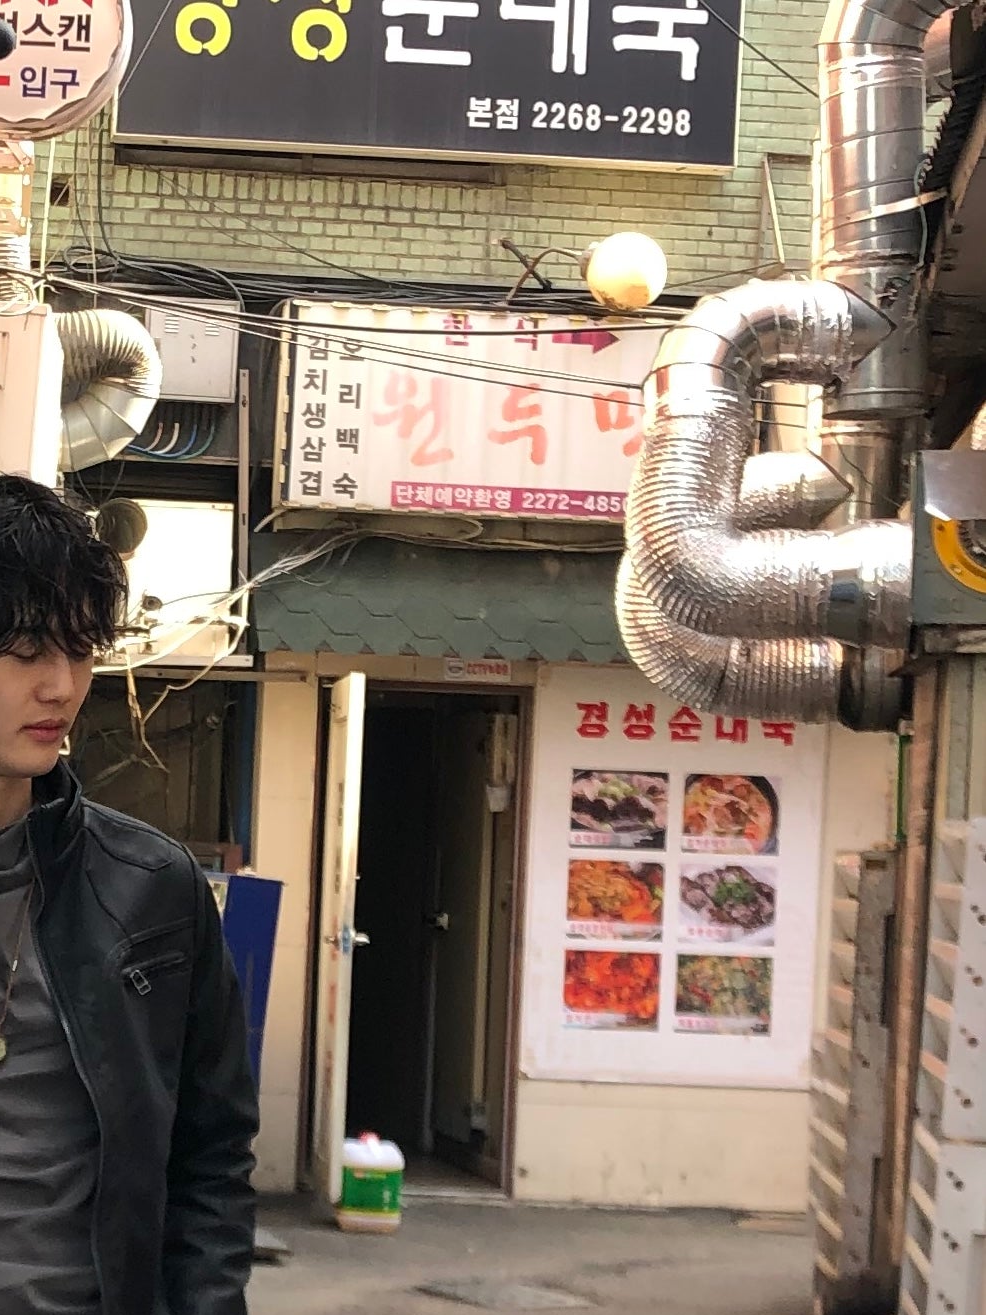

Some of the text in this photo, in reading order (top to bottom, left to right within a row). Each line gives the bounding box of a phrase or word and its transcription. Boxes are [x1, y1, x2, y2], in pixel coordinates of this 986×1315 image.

[20, 66, 80, 99] 입구
[467, 96, 692, 137] 본점 2268-2298
[395, 485, 512, 511] 단체예약환영
